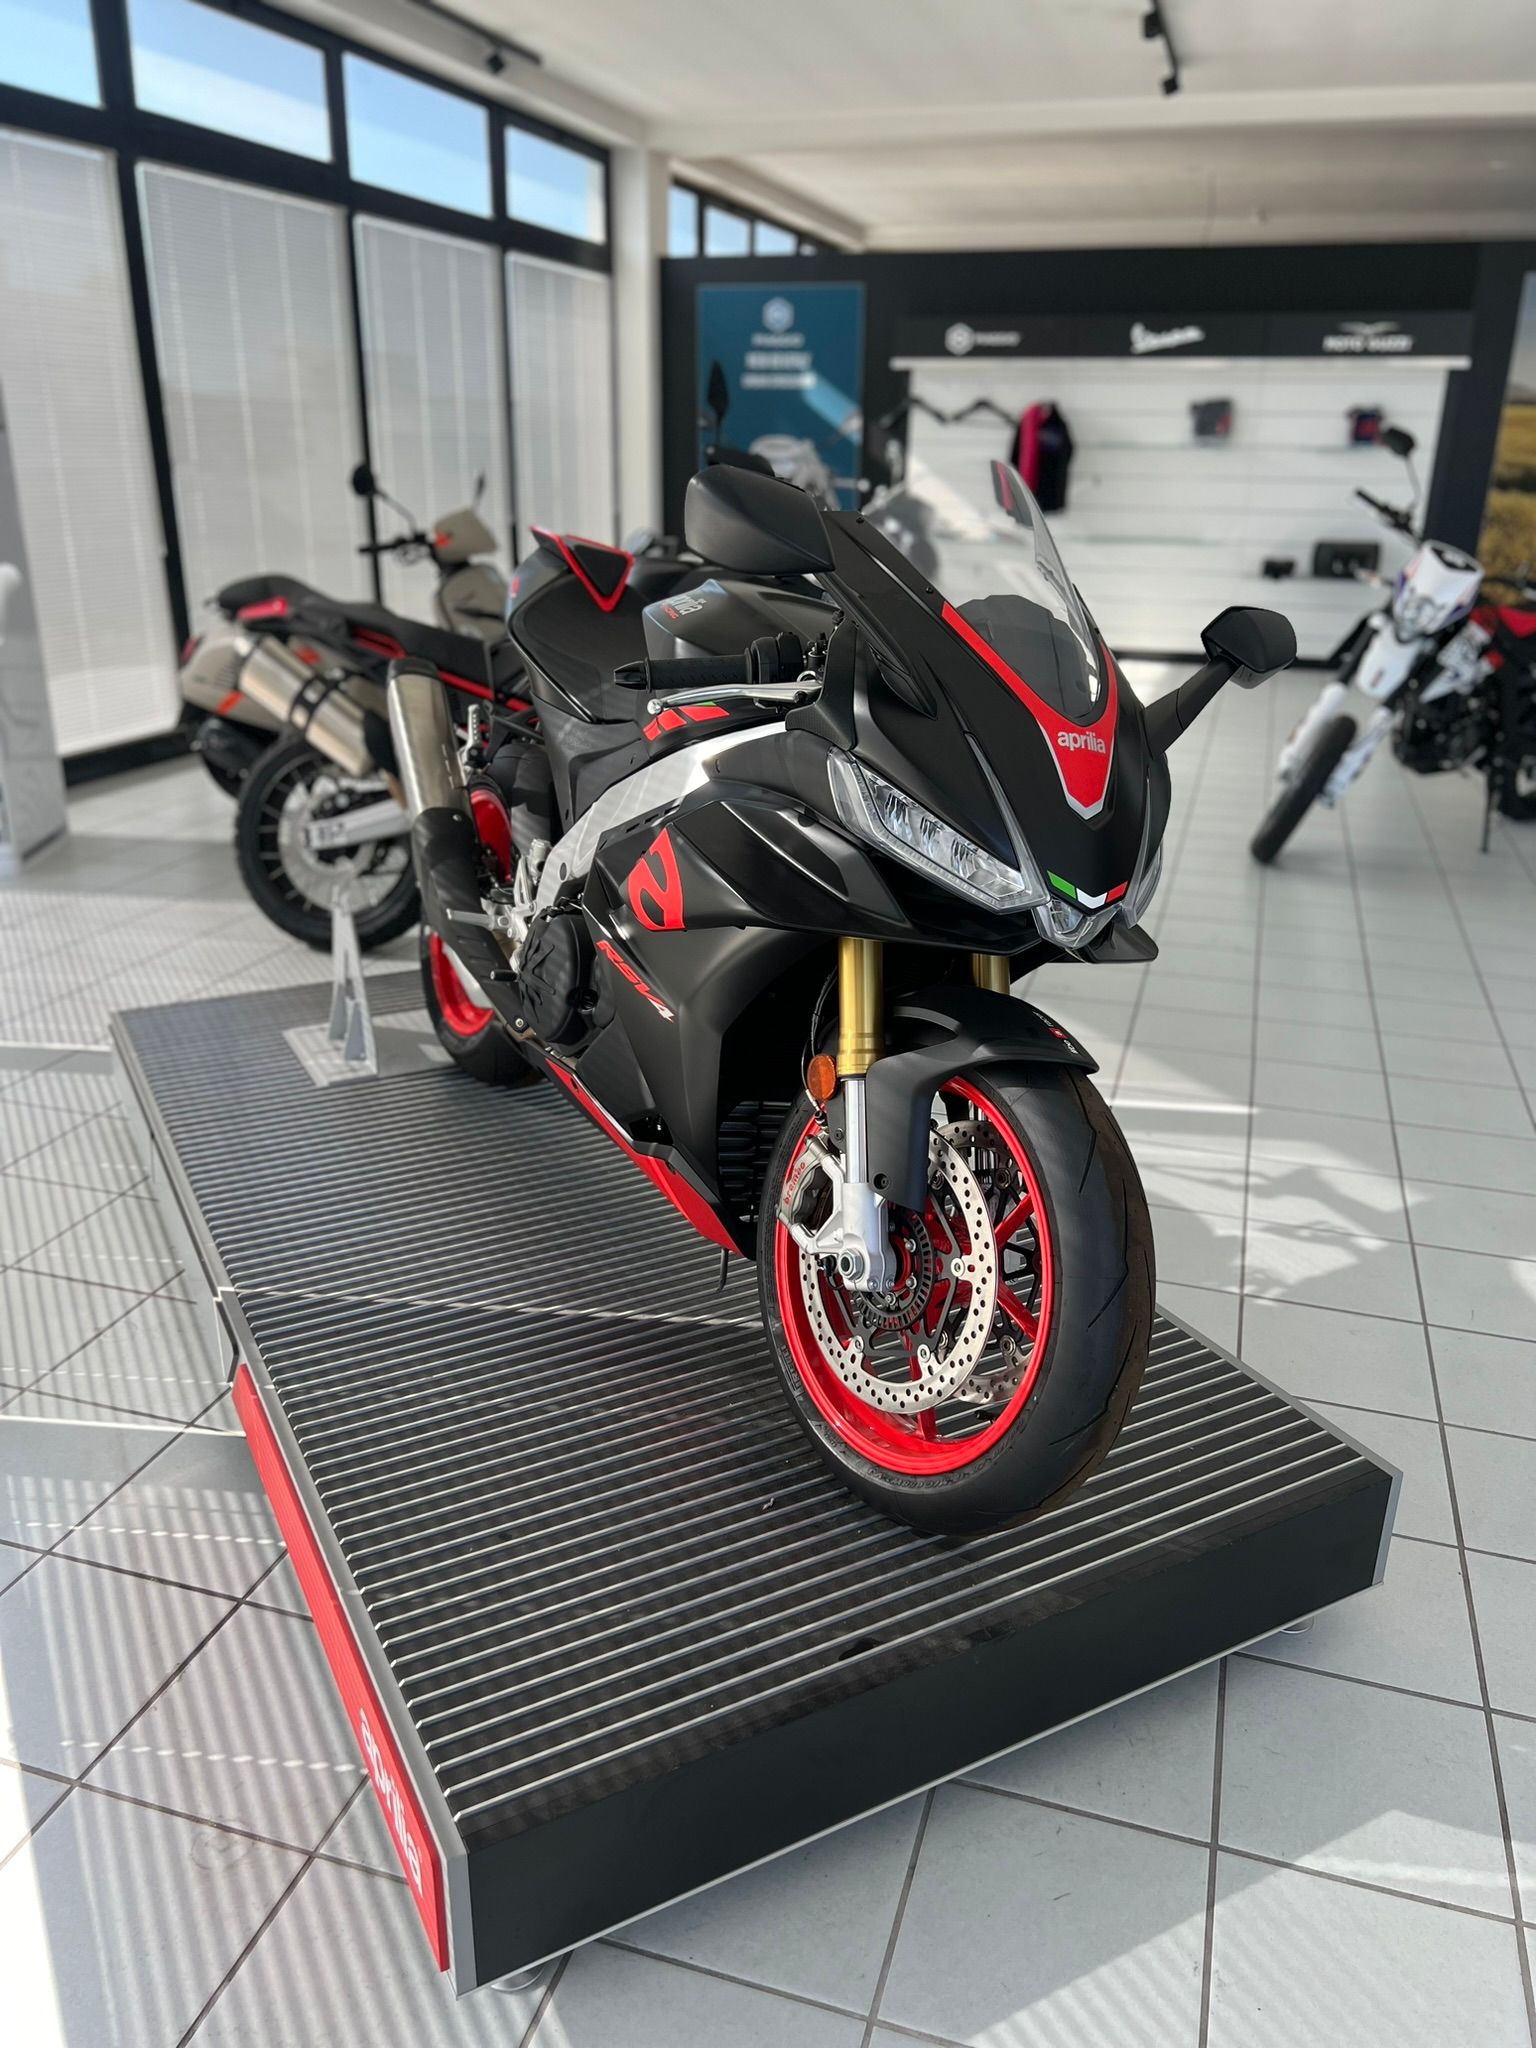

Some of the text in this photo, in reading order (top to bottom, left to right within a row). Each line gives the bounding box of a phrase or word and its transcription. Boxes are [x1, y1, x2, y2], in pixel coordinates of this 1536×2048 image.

[1057, 731, 1106, 755] aprilia
[596, 940, 676, 1024] RSV4
[783, 1162, 806, 1206] brembo
[360, 1707, 423, 1898] aprilia
